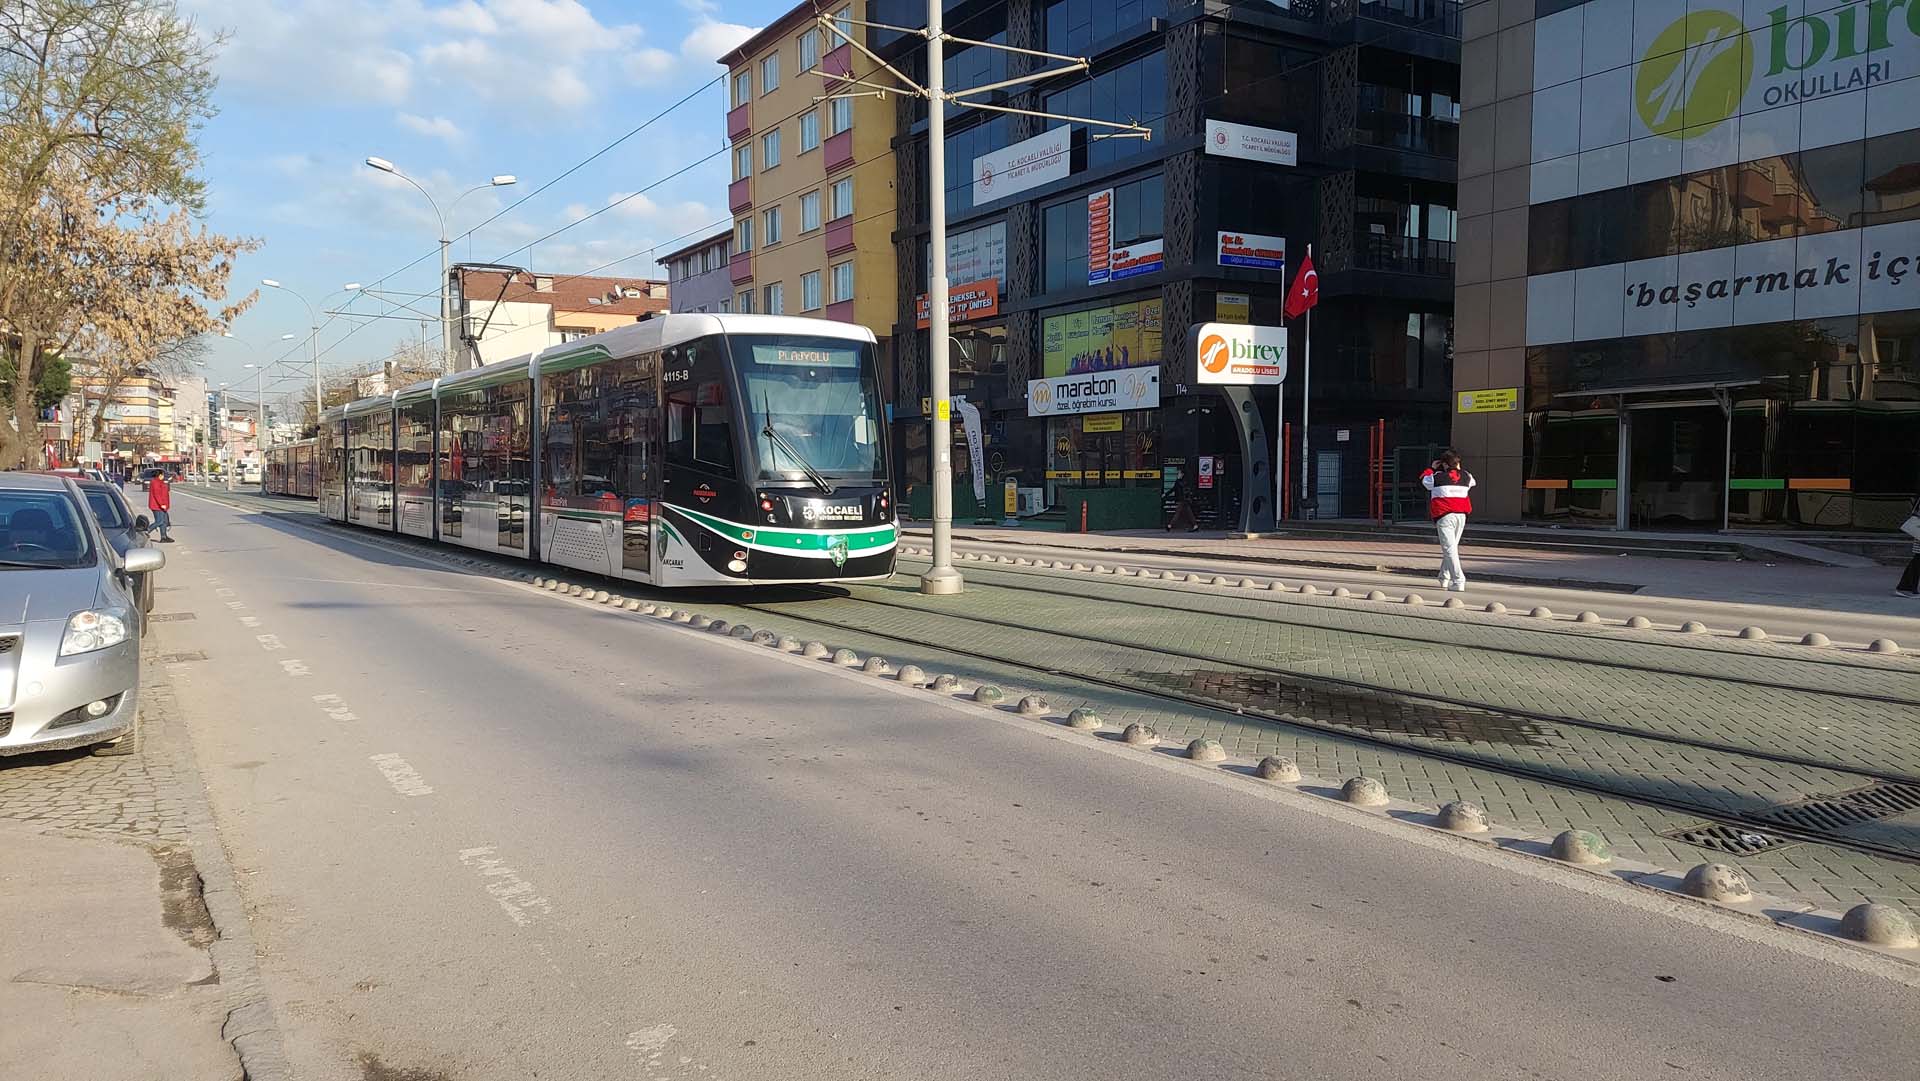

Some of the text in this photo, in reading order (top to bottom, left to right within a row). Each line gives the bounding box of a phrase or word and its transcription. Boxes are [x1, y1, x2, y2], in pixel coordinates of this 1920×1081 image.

[1763, 60, 1890, 105] OKULLARI
[958, 302, 968, 312] TIP
[969, 296, 993, 310] ÜNİTESİ
[1232, 338, 1285, 366] birey
[663, 369, 689, 382] 4115-B
[1232, 367, 1279, 376] ANADOLU LİSESİ
[1056, 374, 1117, 400] maraton
[1175, 383, 1188, 396] 114
[1056, 397, 1117, 413] özel öğretim kursu
